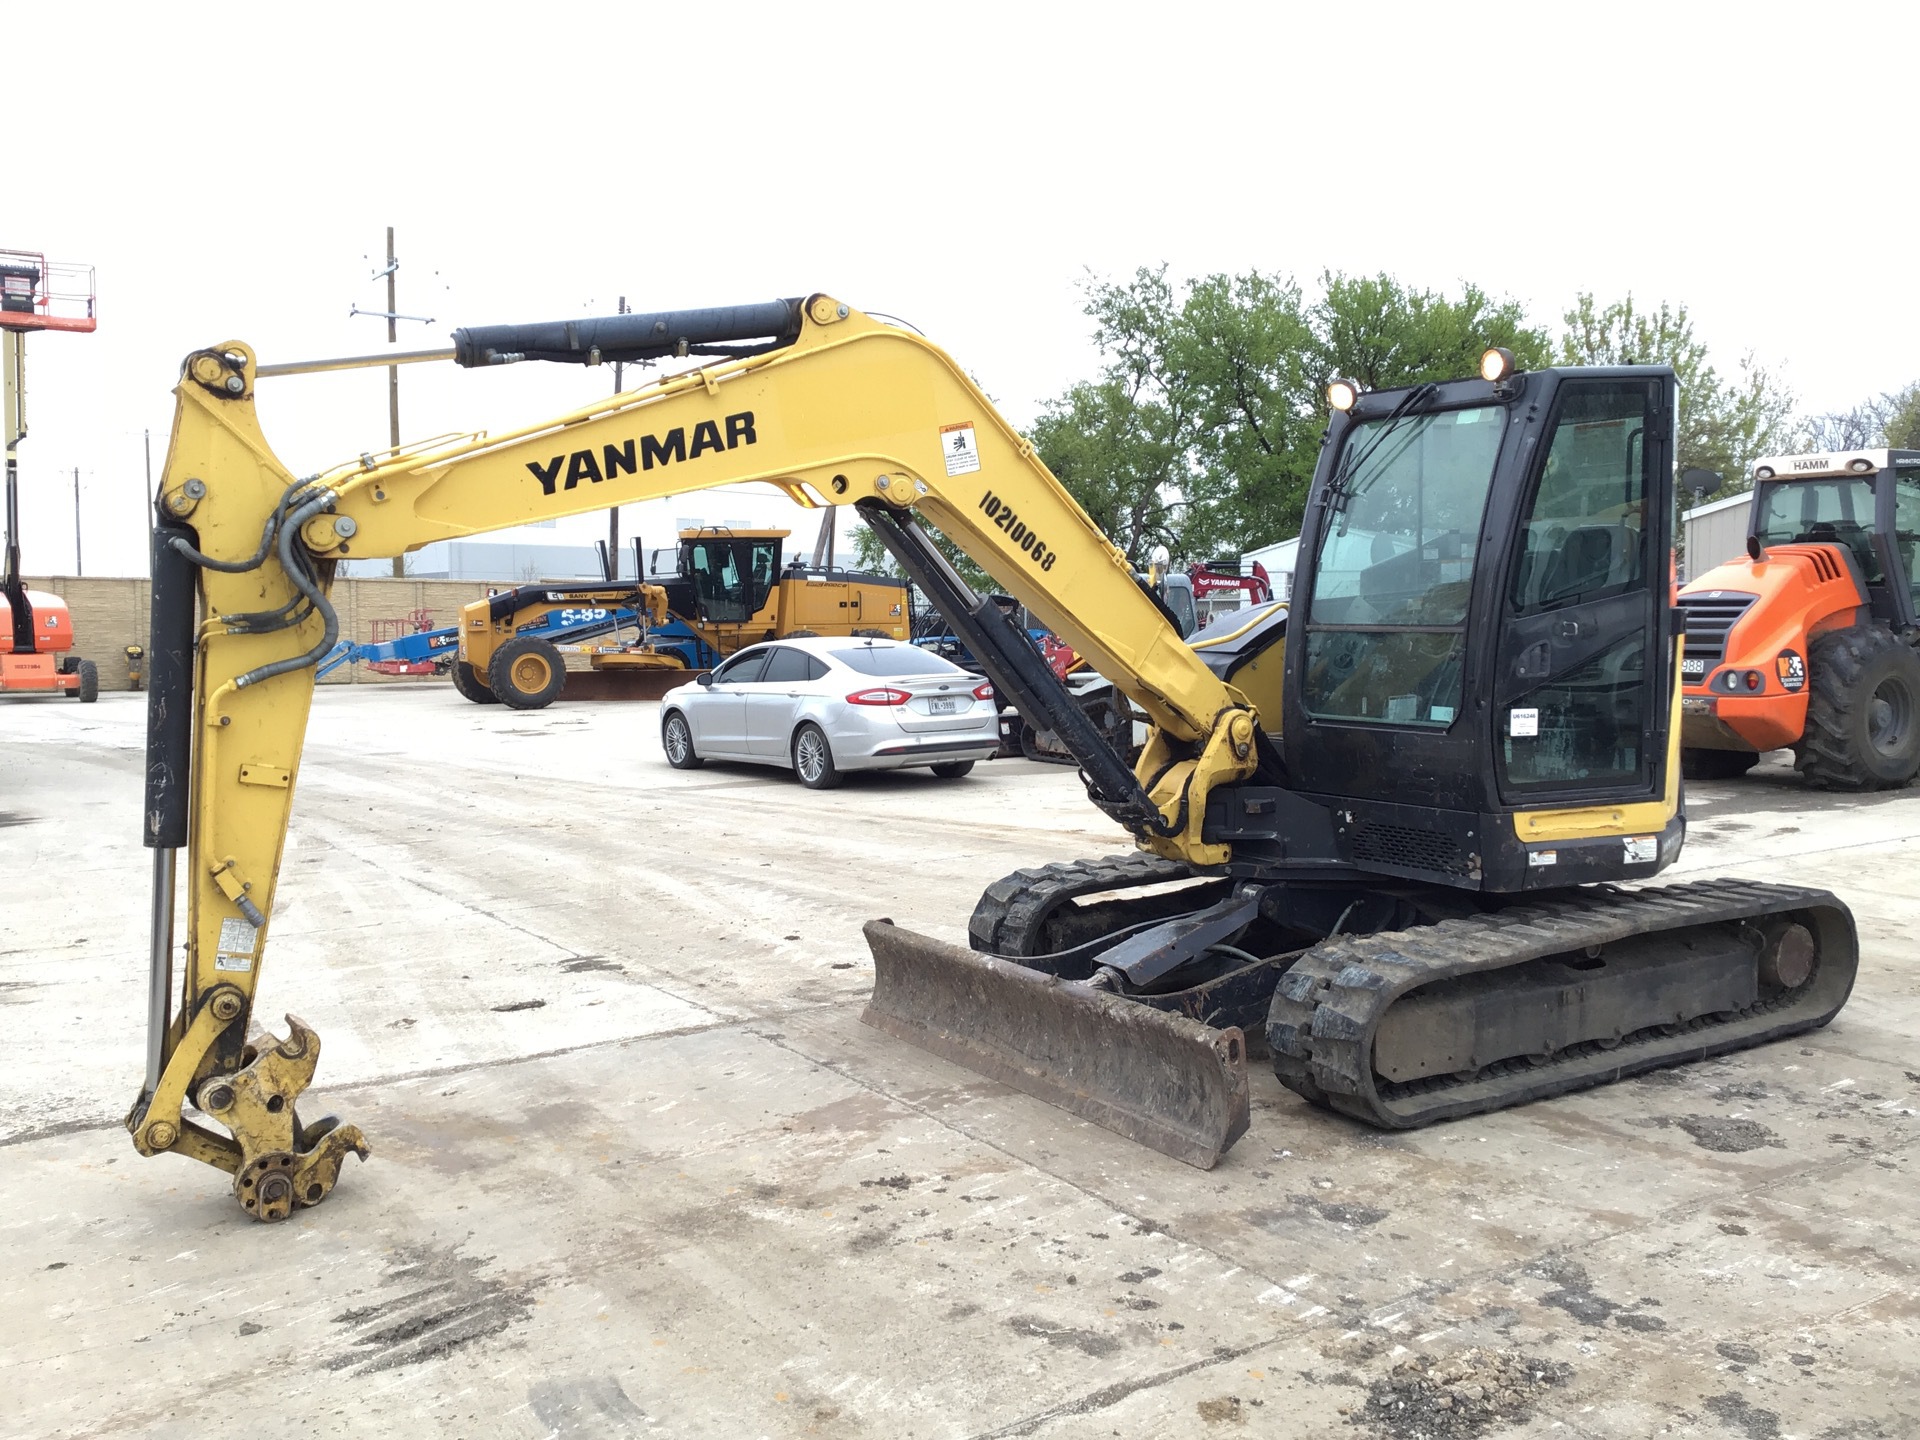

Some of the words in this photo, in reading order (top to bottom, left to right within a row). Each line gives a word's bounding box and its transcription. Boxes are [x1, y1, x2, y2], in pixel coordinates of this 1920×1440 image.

[525, 411, 757, 495] YANMAR
[1794, 460, 1829, 470] HAMM
[979, 490, 1056, 572] 10210068
[1778, 656, 1803, 677] H&E
